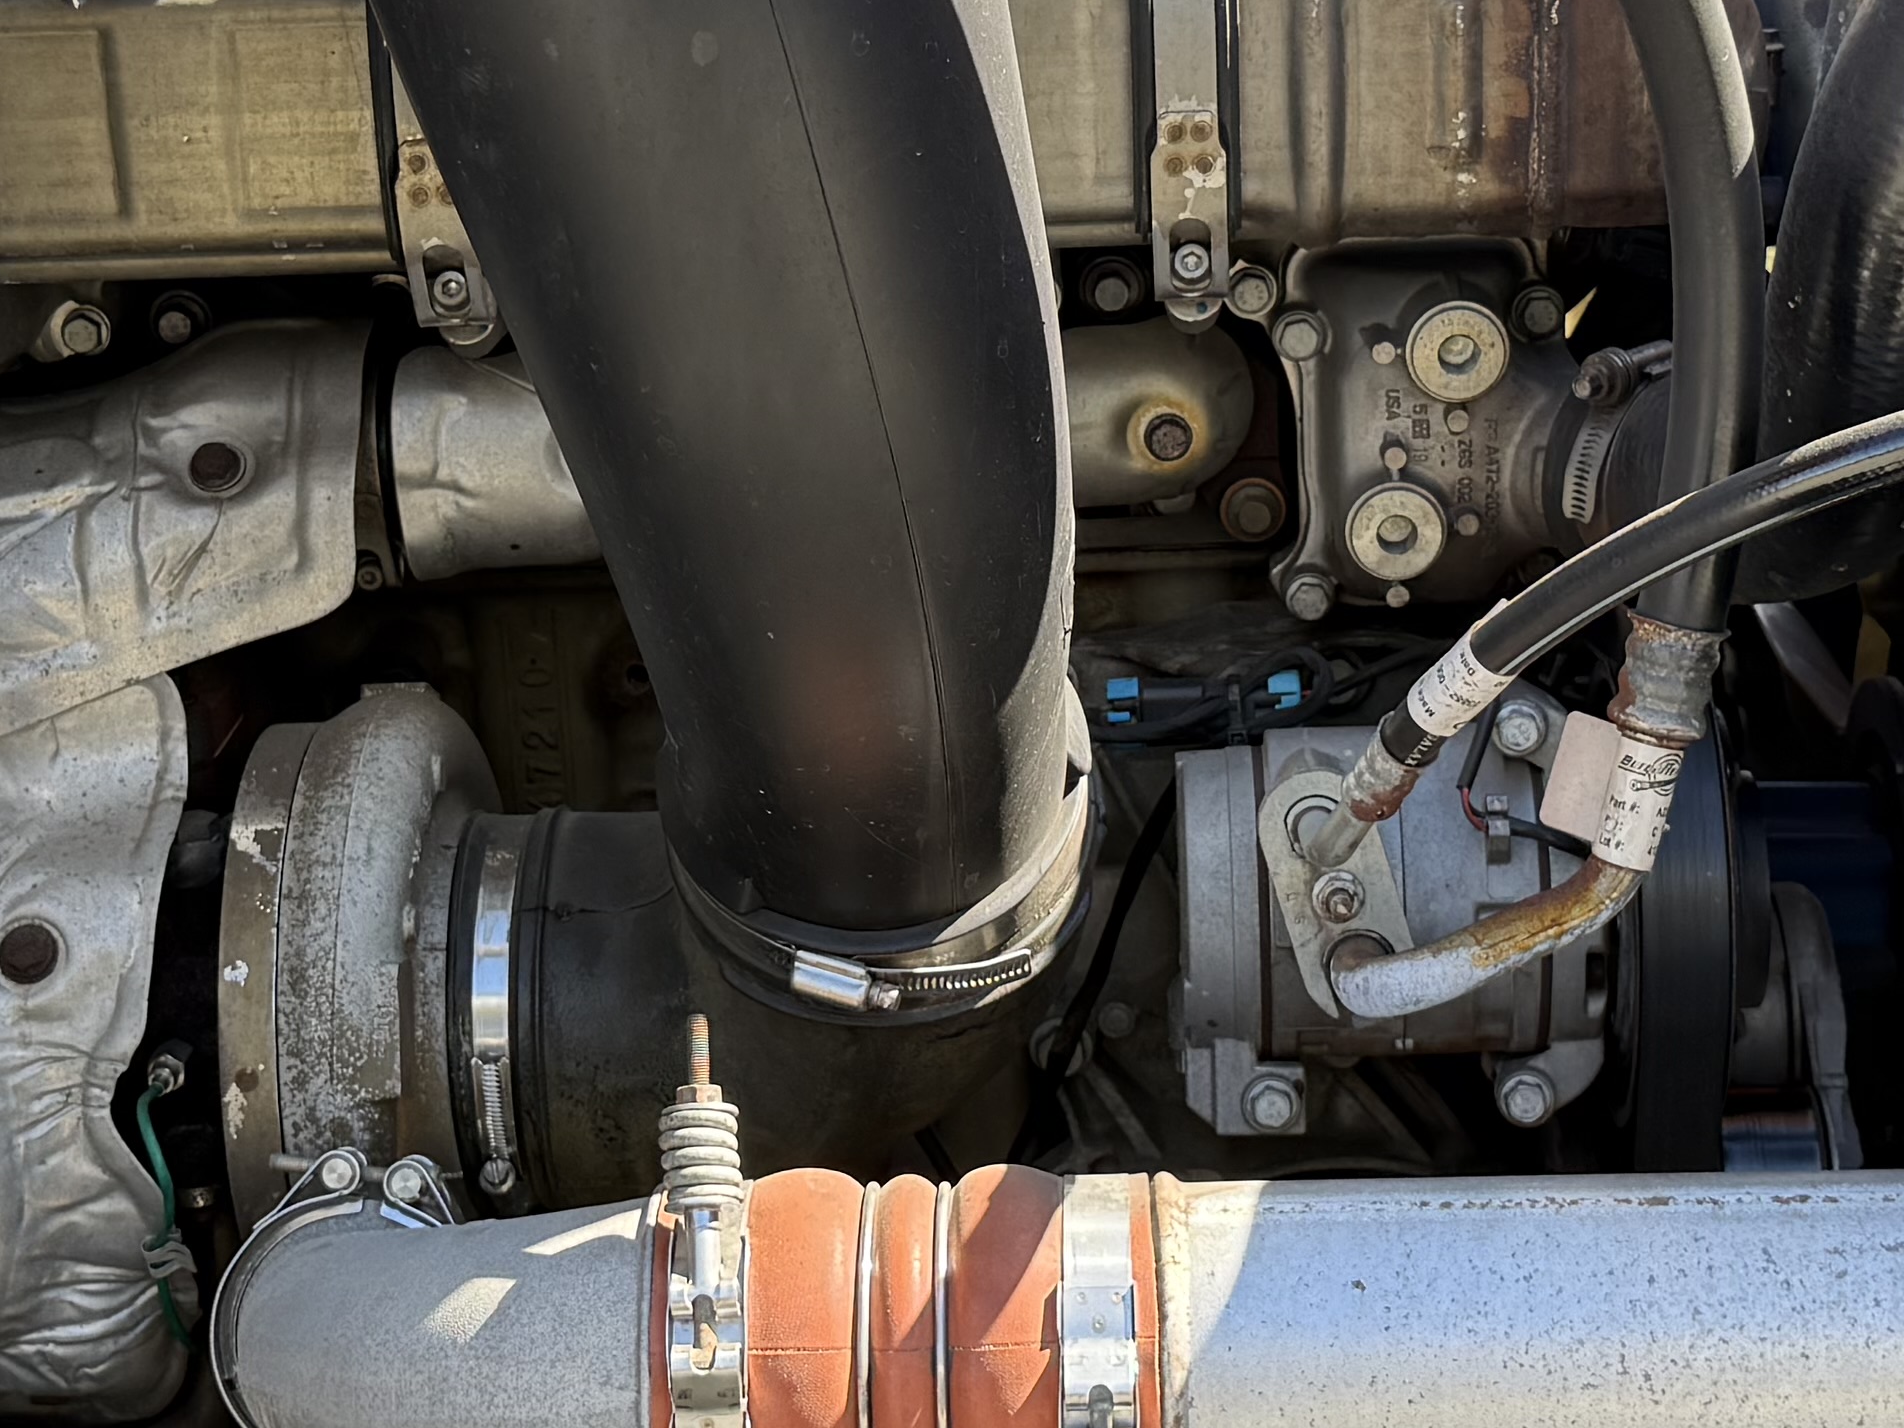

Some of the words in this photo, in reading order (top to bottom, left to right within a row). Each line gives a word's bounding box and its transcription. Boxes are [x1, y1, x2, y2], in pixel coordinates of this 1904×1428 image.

[1385, 388, 1401, 421] USA
[1412, 447, 1429, 463] 19
[1456, 476, 1473, 504] 002
[1608, 794, 1626, 812] Part
